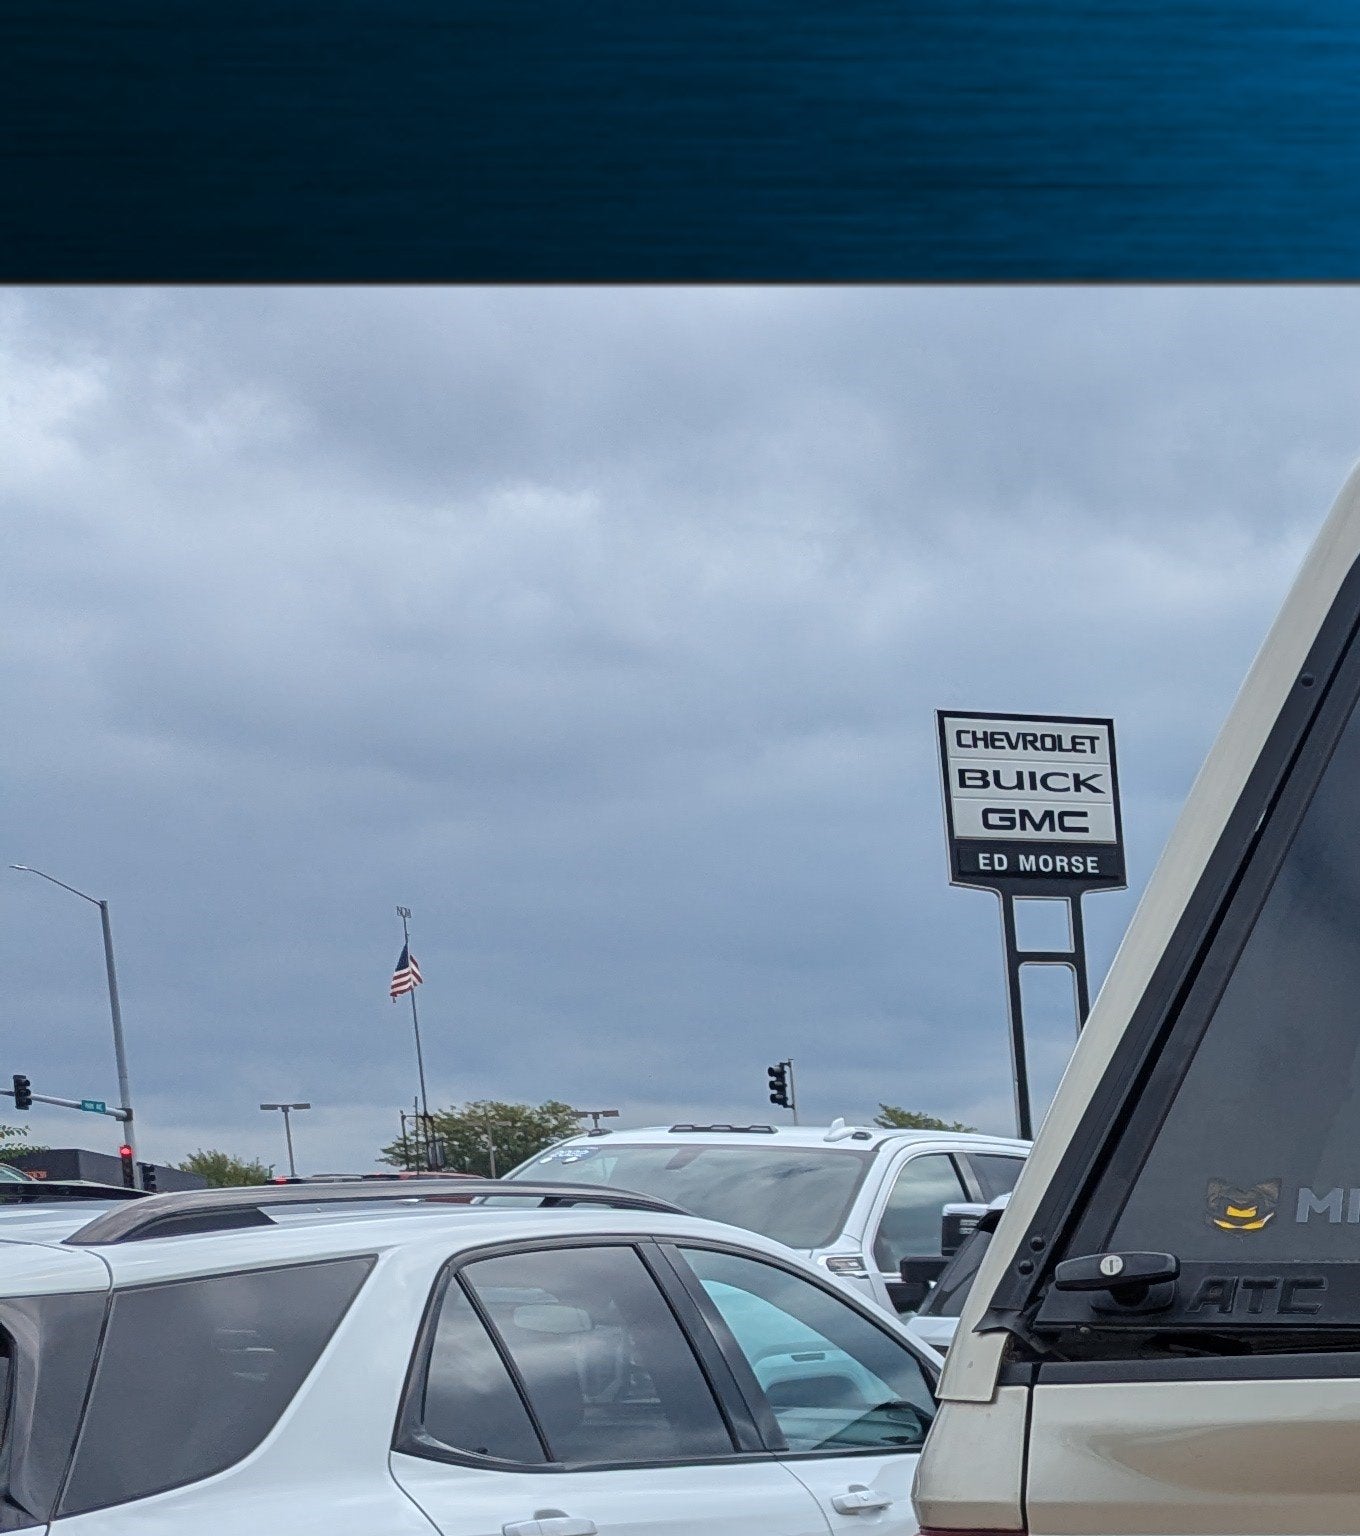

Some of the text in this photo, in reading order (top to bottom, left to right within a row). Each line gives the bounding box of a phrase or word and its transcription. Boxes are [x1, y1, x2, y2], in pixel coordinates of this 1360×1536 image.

[955, 729, 1100, 754] CHEVROLET
[957, 768, 1106, 794] BUICK
[981, 807, 1090, 833] GMC
[978, 852, 1100, 874] ED MORSE
[1184, 1275, 1329, 1315] ATC
